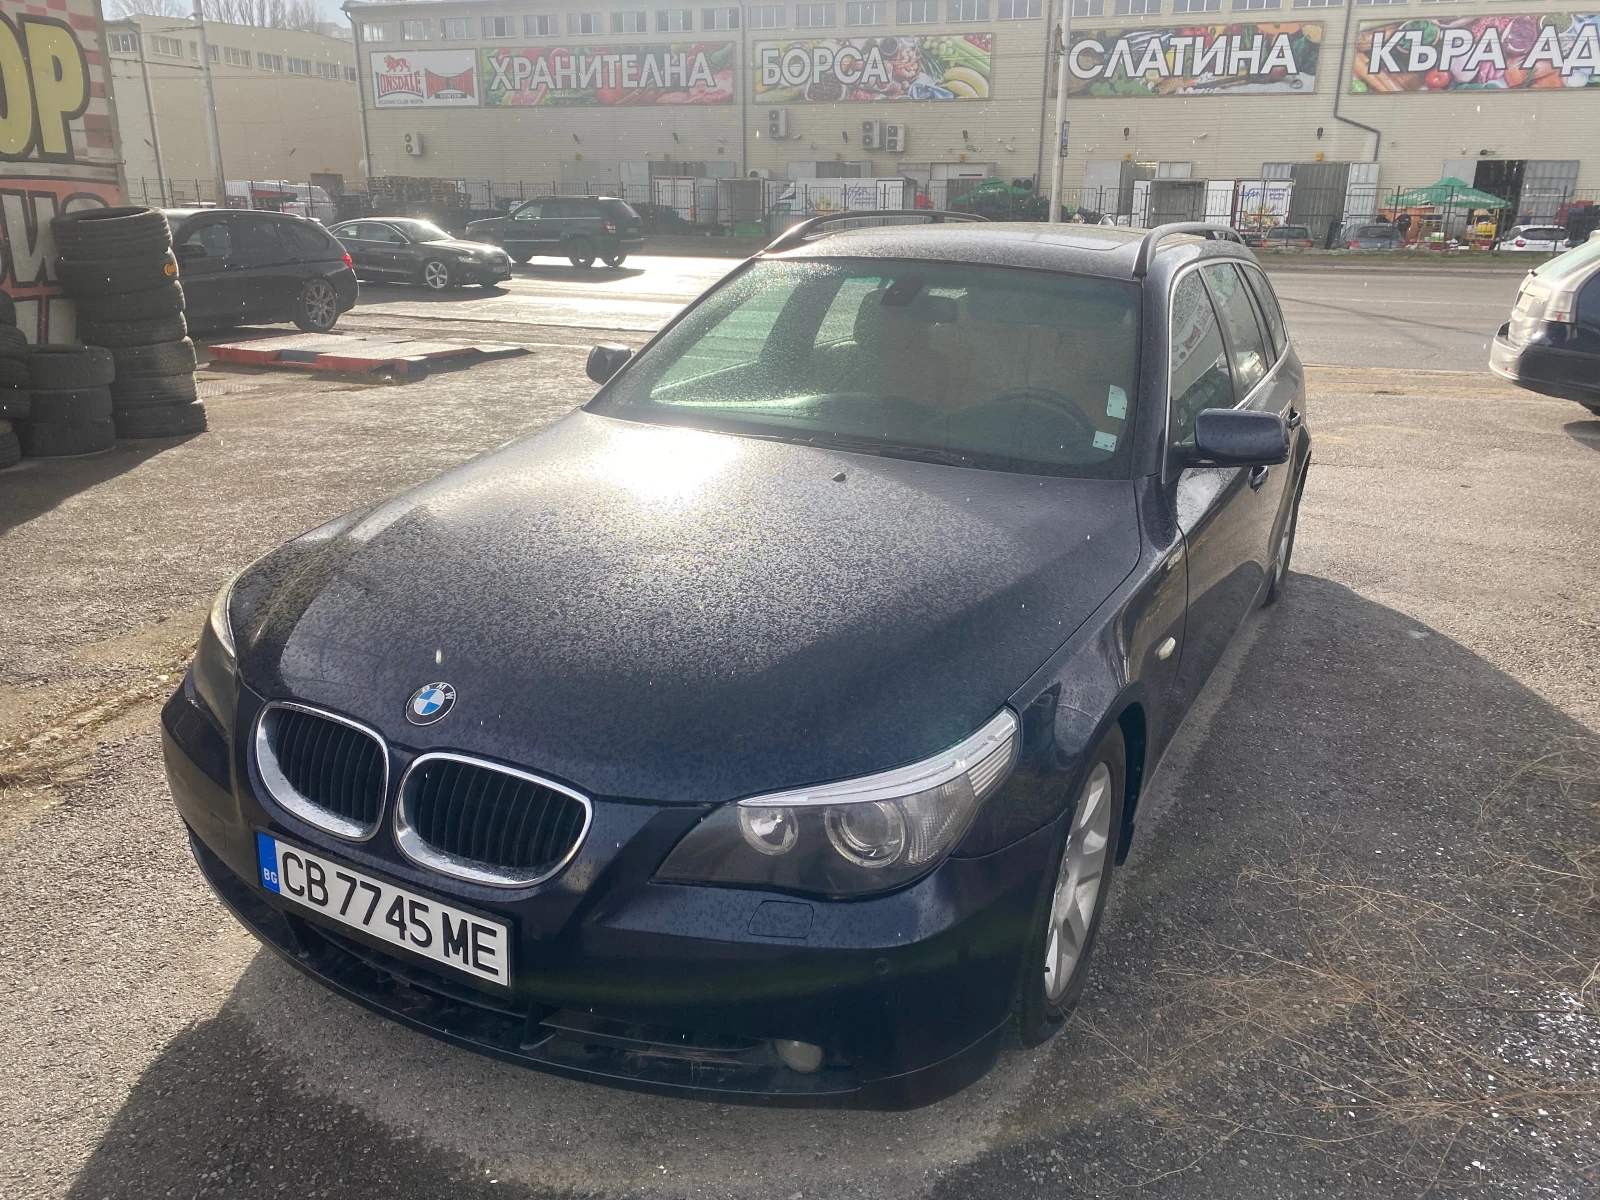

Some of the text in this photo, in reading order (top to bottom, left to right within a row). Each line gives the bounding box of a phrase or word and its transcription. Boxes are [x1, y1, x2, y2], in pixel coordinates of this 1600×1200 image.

[487, 52, 717, 90] ХРАНИТЕЛНА
[761, 46, 890, 86] БОРСА
[1068, 32, 1298, 79] СЛАТИНА
[1368, 26, 1507, 74] КЪРА
[375, 70, 424, 99] LONSDALE
[263, 867, 278, 884] BG
[281, 851, 500, 977] CB 7745 ME
